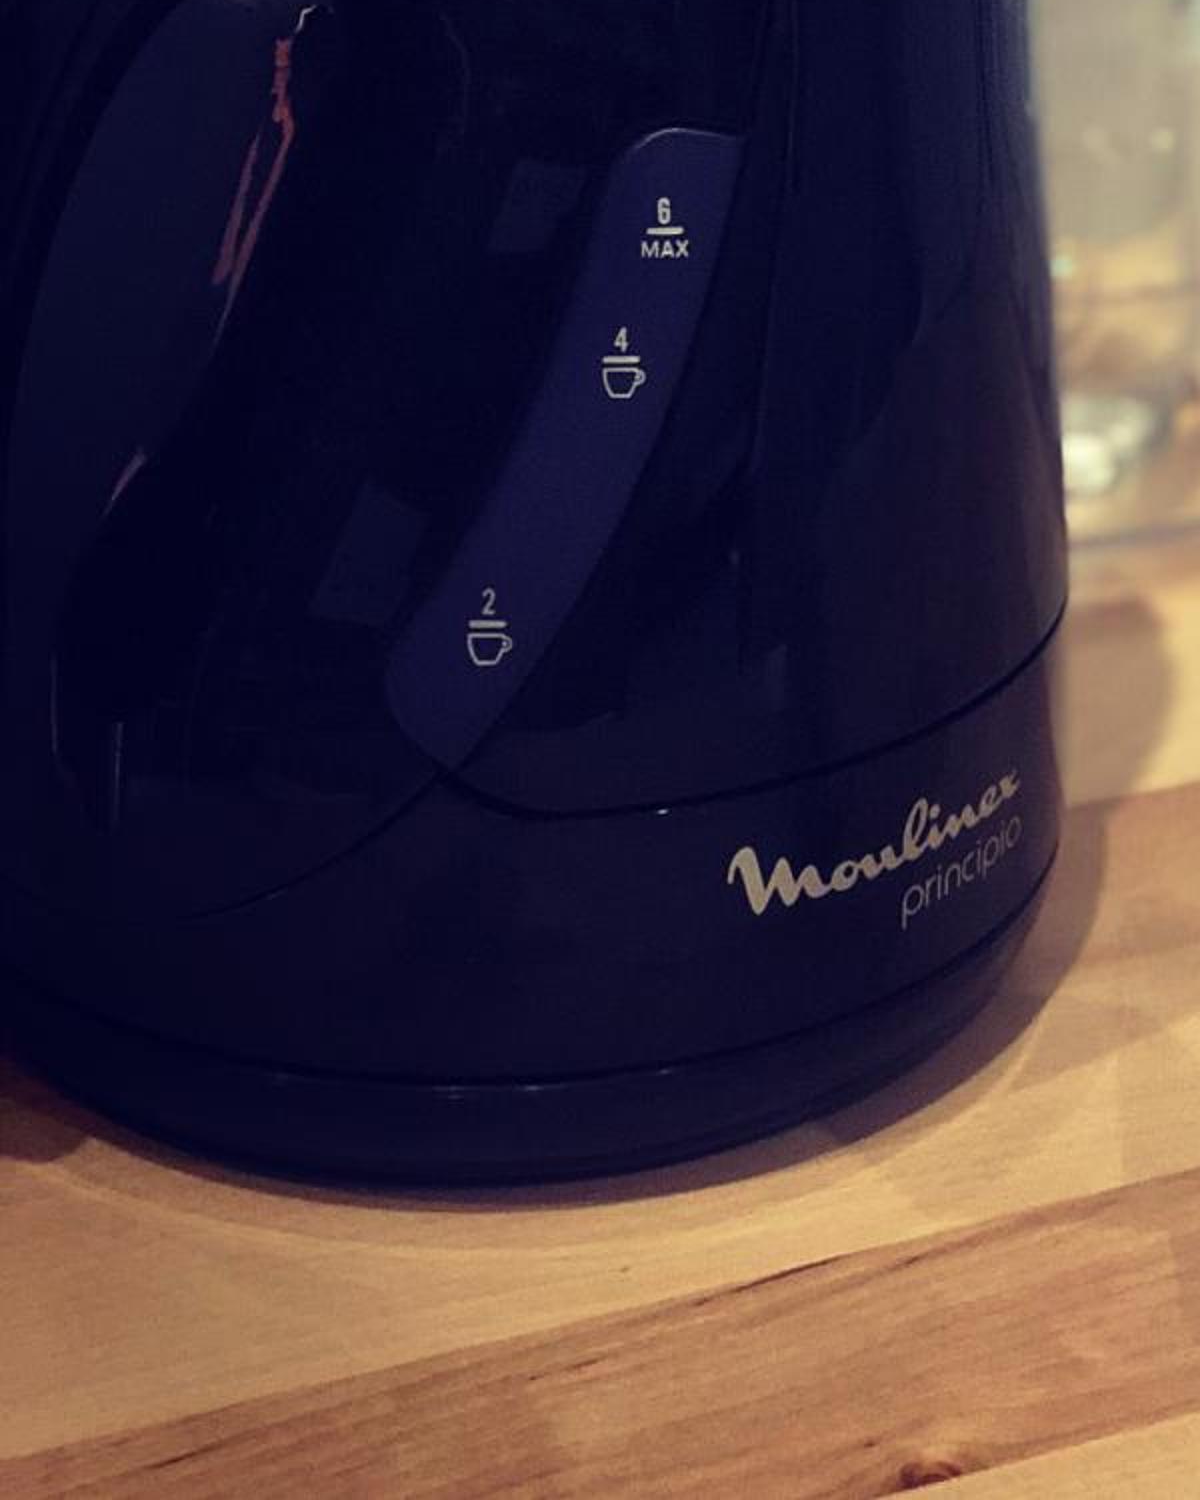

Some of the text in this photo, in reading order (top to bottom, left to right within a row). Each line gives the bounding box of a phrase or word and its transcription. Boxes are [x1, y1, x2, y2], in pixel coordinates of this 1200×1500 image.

[656, 197, 672, 225] 6
[640, 239, 690, 259] MAX
[613, 327, 630, 353] 4
[481, 588, 496, 615] 2
[727, 768, 1021, 915] Moulinex
[901, 815, 1022, 930] principio
